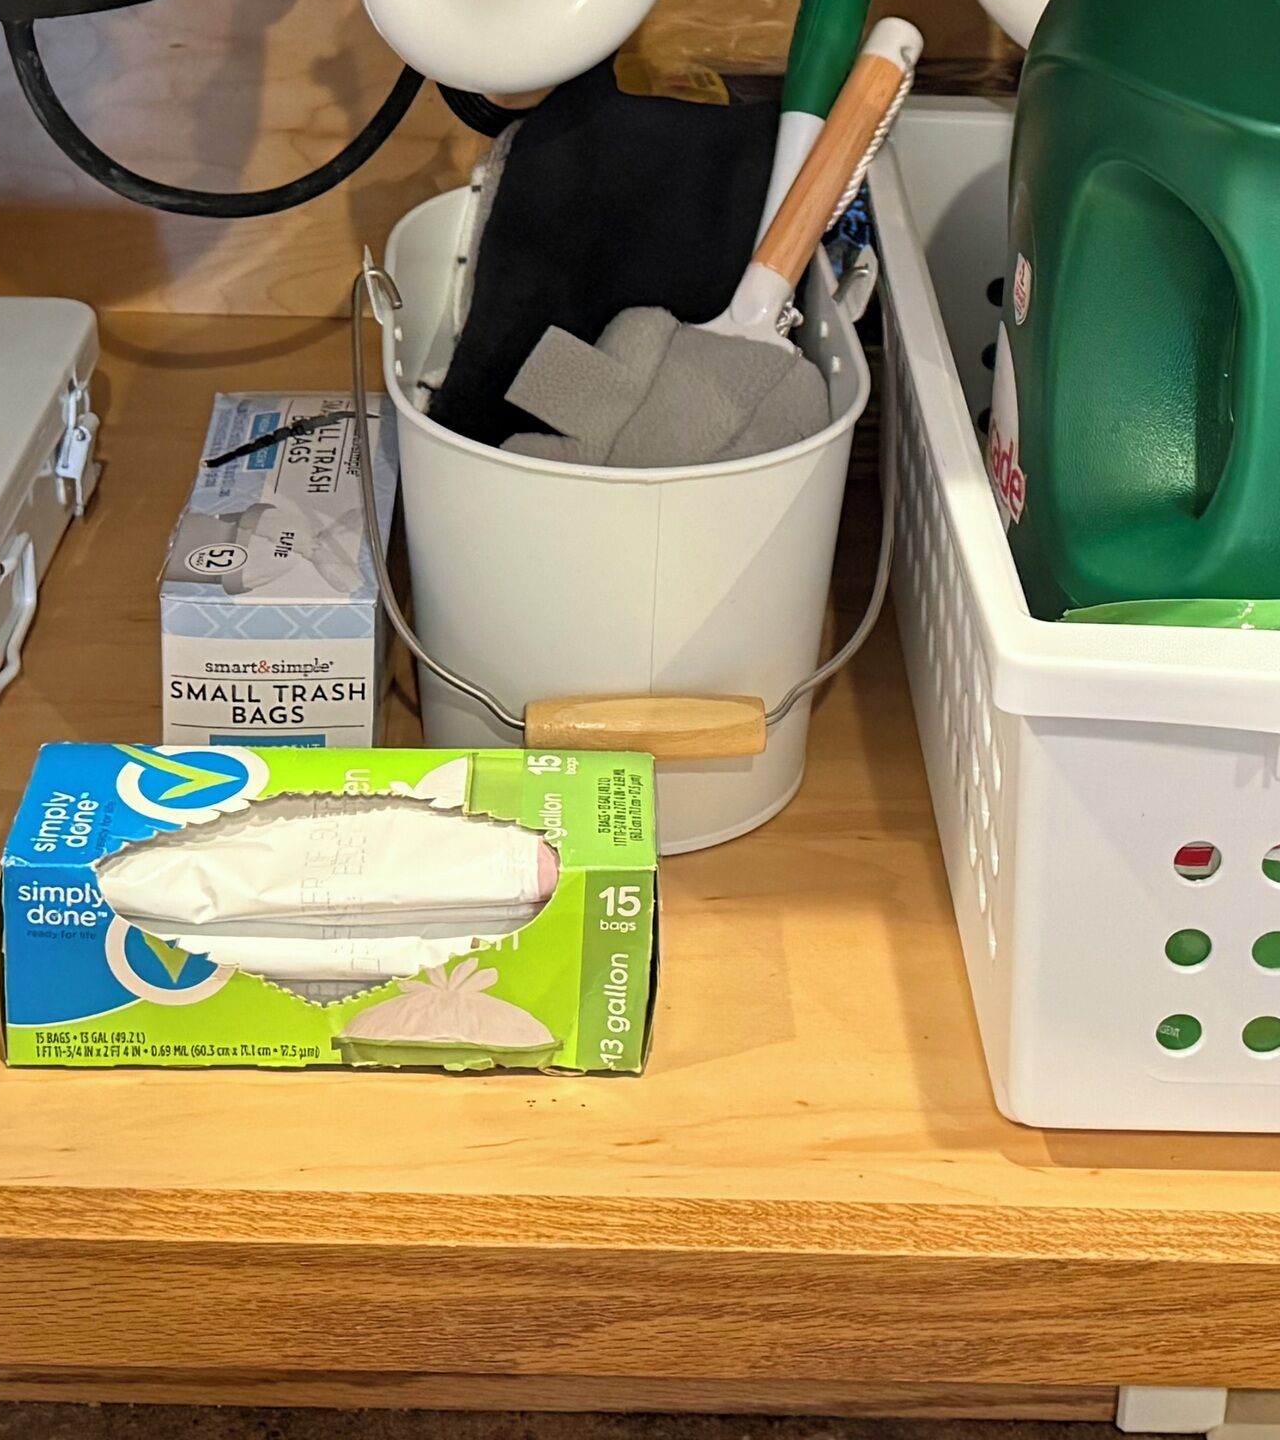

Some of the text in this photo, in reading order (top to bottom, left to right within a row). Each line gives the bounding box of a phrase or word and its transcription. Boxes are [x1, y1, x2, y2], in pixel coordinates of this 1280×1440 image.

[307, 448, 337, 495] TRASH
[205, 549, 235, 569] 52
[170, 680, 366, 703] SMALL TRASH
[232, 705, 305, 724] BAGS
[527, 754, 563, 775] 15
[564, 756, 579, 776] bags
[30, 791, 76, 853] simply
[18, 881, 105, 908] simply
[598, 885, 642, 918] 15
[27, 929, 97, 940] ready for life
[599, 919, 637, 933] bags
[600, 953, 630, 1065] 13 gallon
[35, 1031, 146, 1045] 15 BAGS 13 GAL (49.2 L)
[42, 1045, 53, 1058] FT
[84, 1045, 94, 1058] IN
[95, 1047, 102, 1057] x
[103, 1045, 110, 1057] 2
[111, 1045, 121, 1057] FT
[123, 1045, 131, 1057] 4
[132, 1045, 142, 1057] IN
[151, 1045, 172, 1057] 0.69
[232, 1047, 239, 1057] x
[257, 1047, 271, 1057] cm
